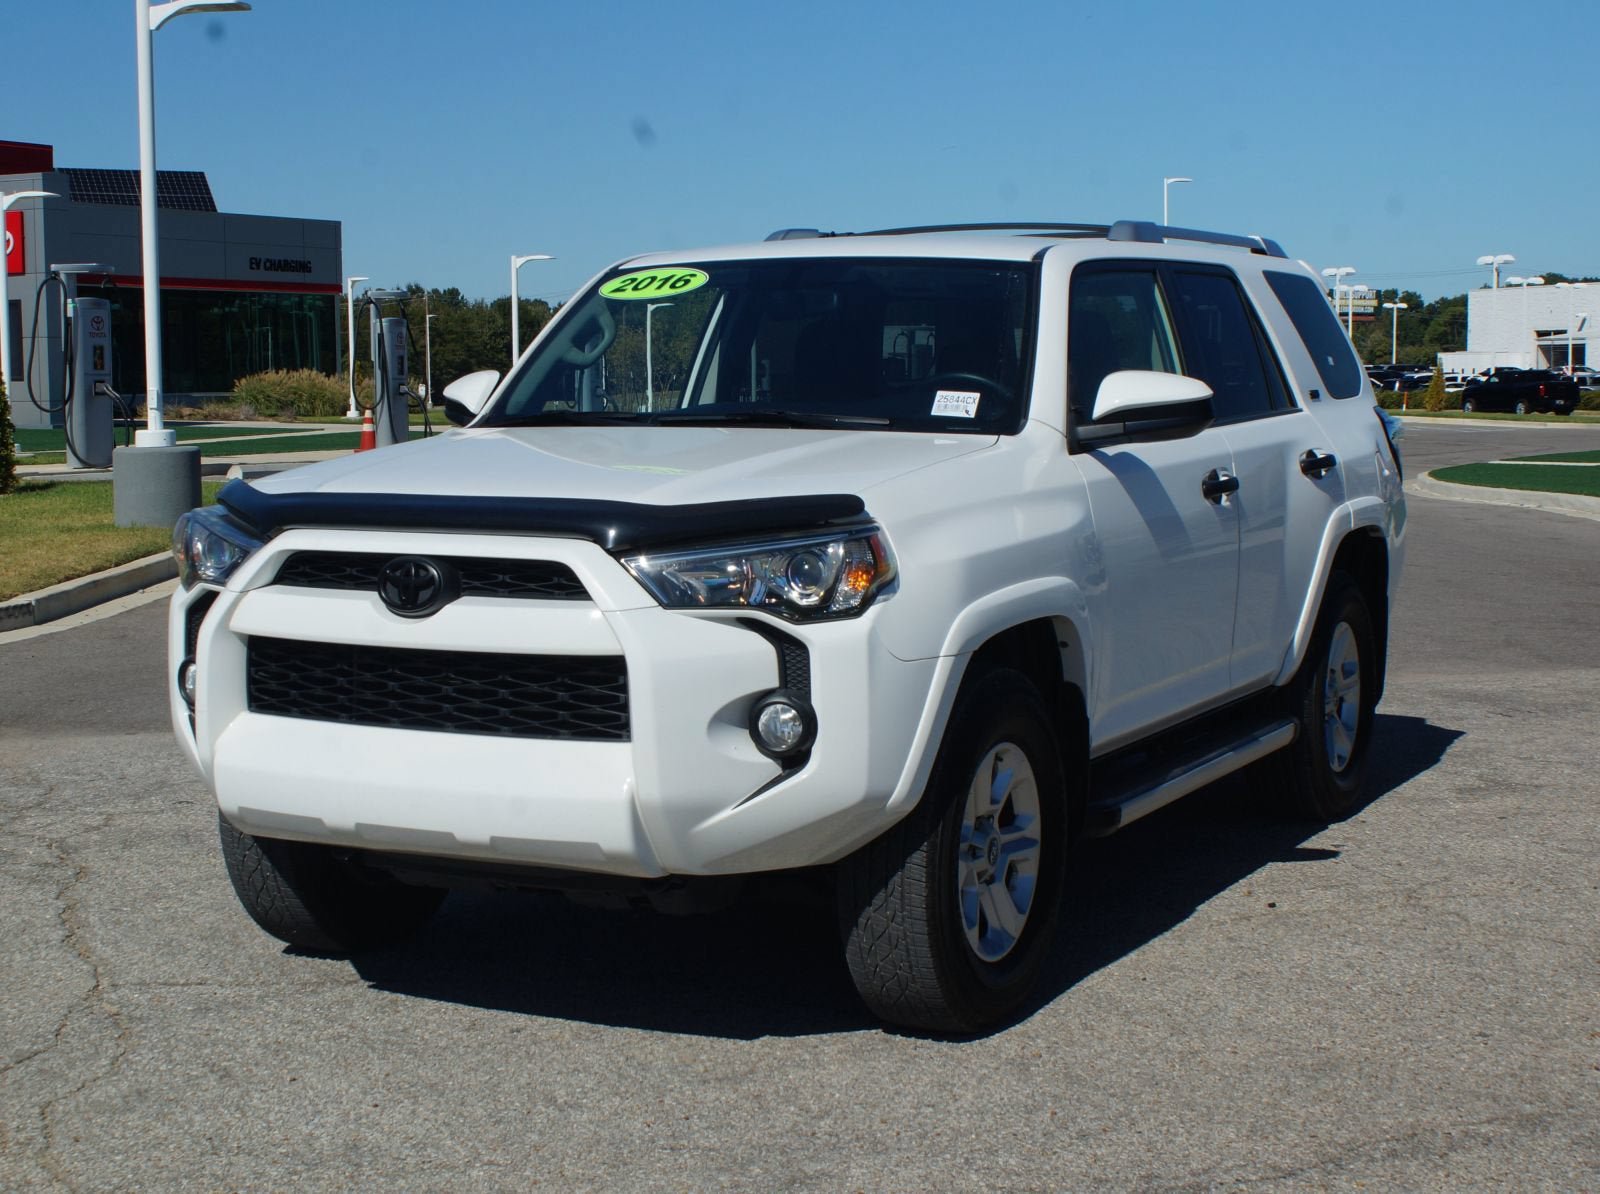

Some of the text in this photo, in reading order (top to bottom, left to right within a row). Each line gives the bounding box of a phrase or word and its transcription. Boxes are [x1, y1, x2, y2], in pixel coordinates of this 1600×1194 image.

[249, 257, 312, 273] EV CHARGING
[608, 273, 697, 294] 2016
